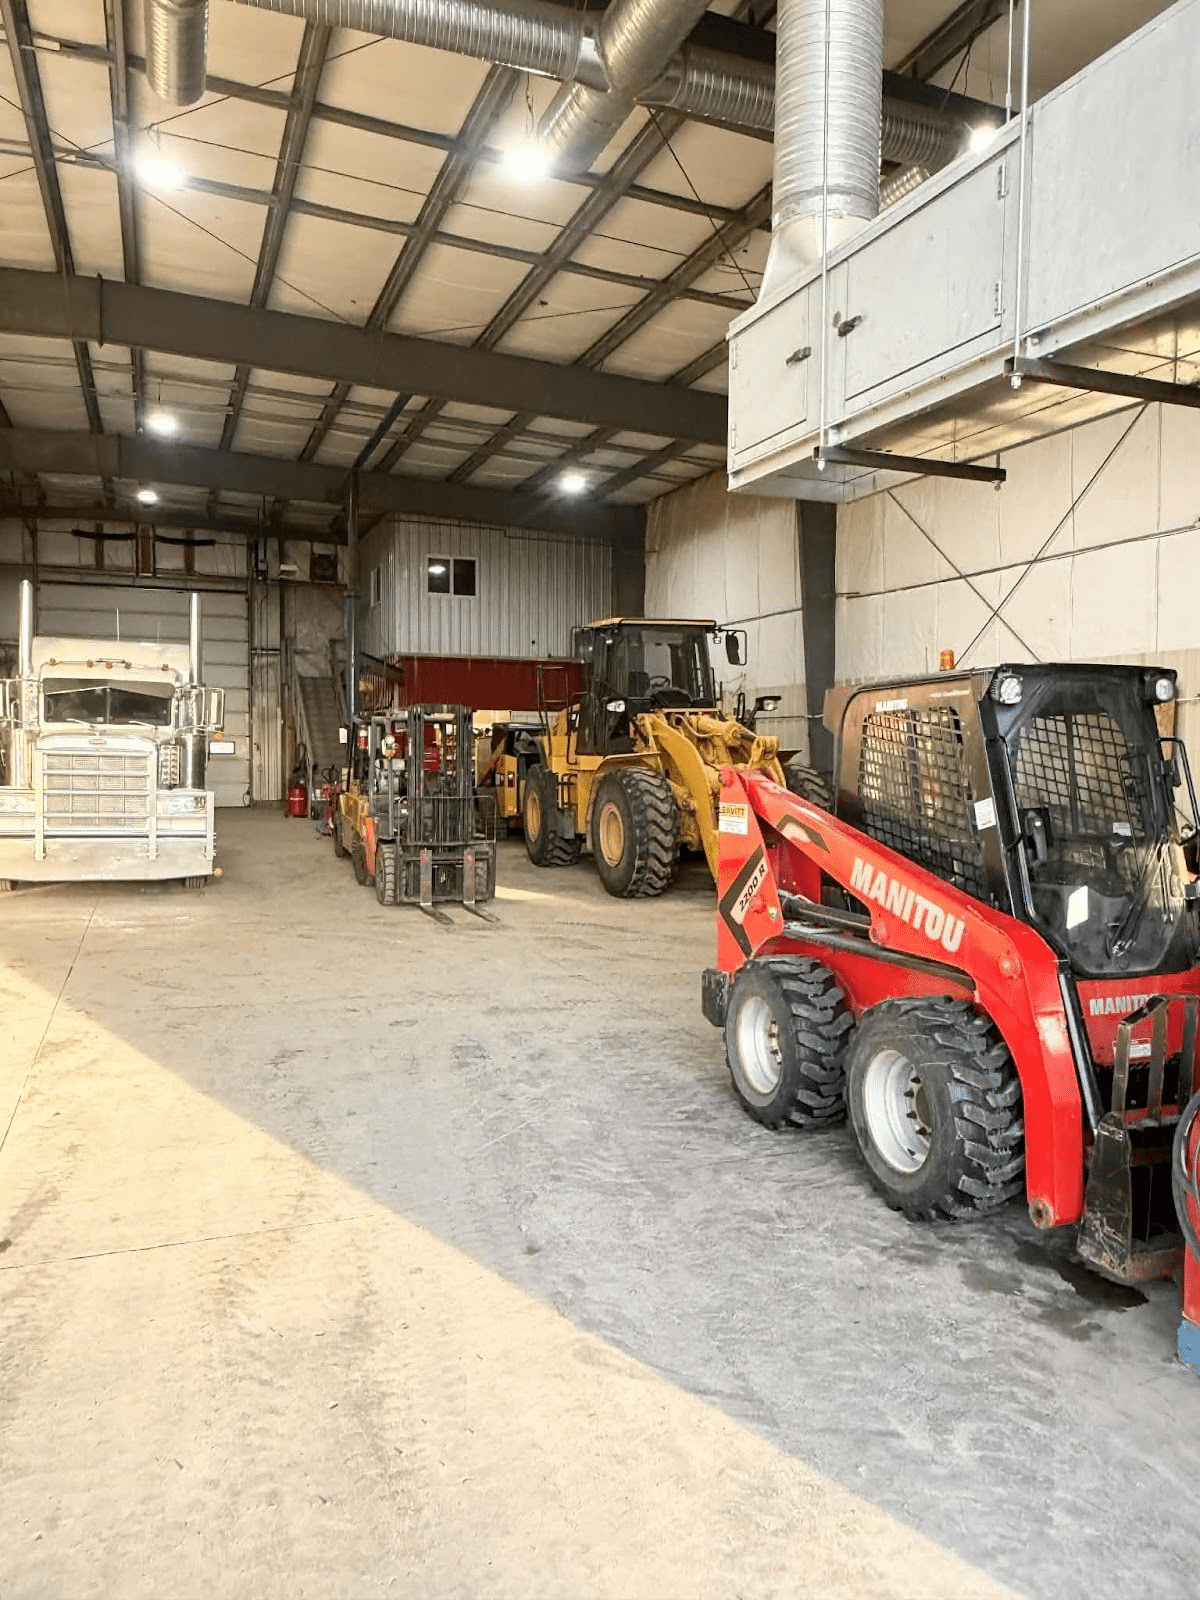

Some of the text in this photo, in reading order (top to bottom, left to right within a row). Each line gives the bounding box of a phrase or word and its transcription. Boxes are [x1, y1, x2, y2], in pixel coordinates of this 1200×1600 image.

[739, 876, 759, 912] 2200
[850, 857, 966, 953] MANITOU
[1090, 994, 1158, 1016] MANIT
